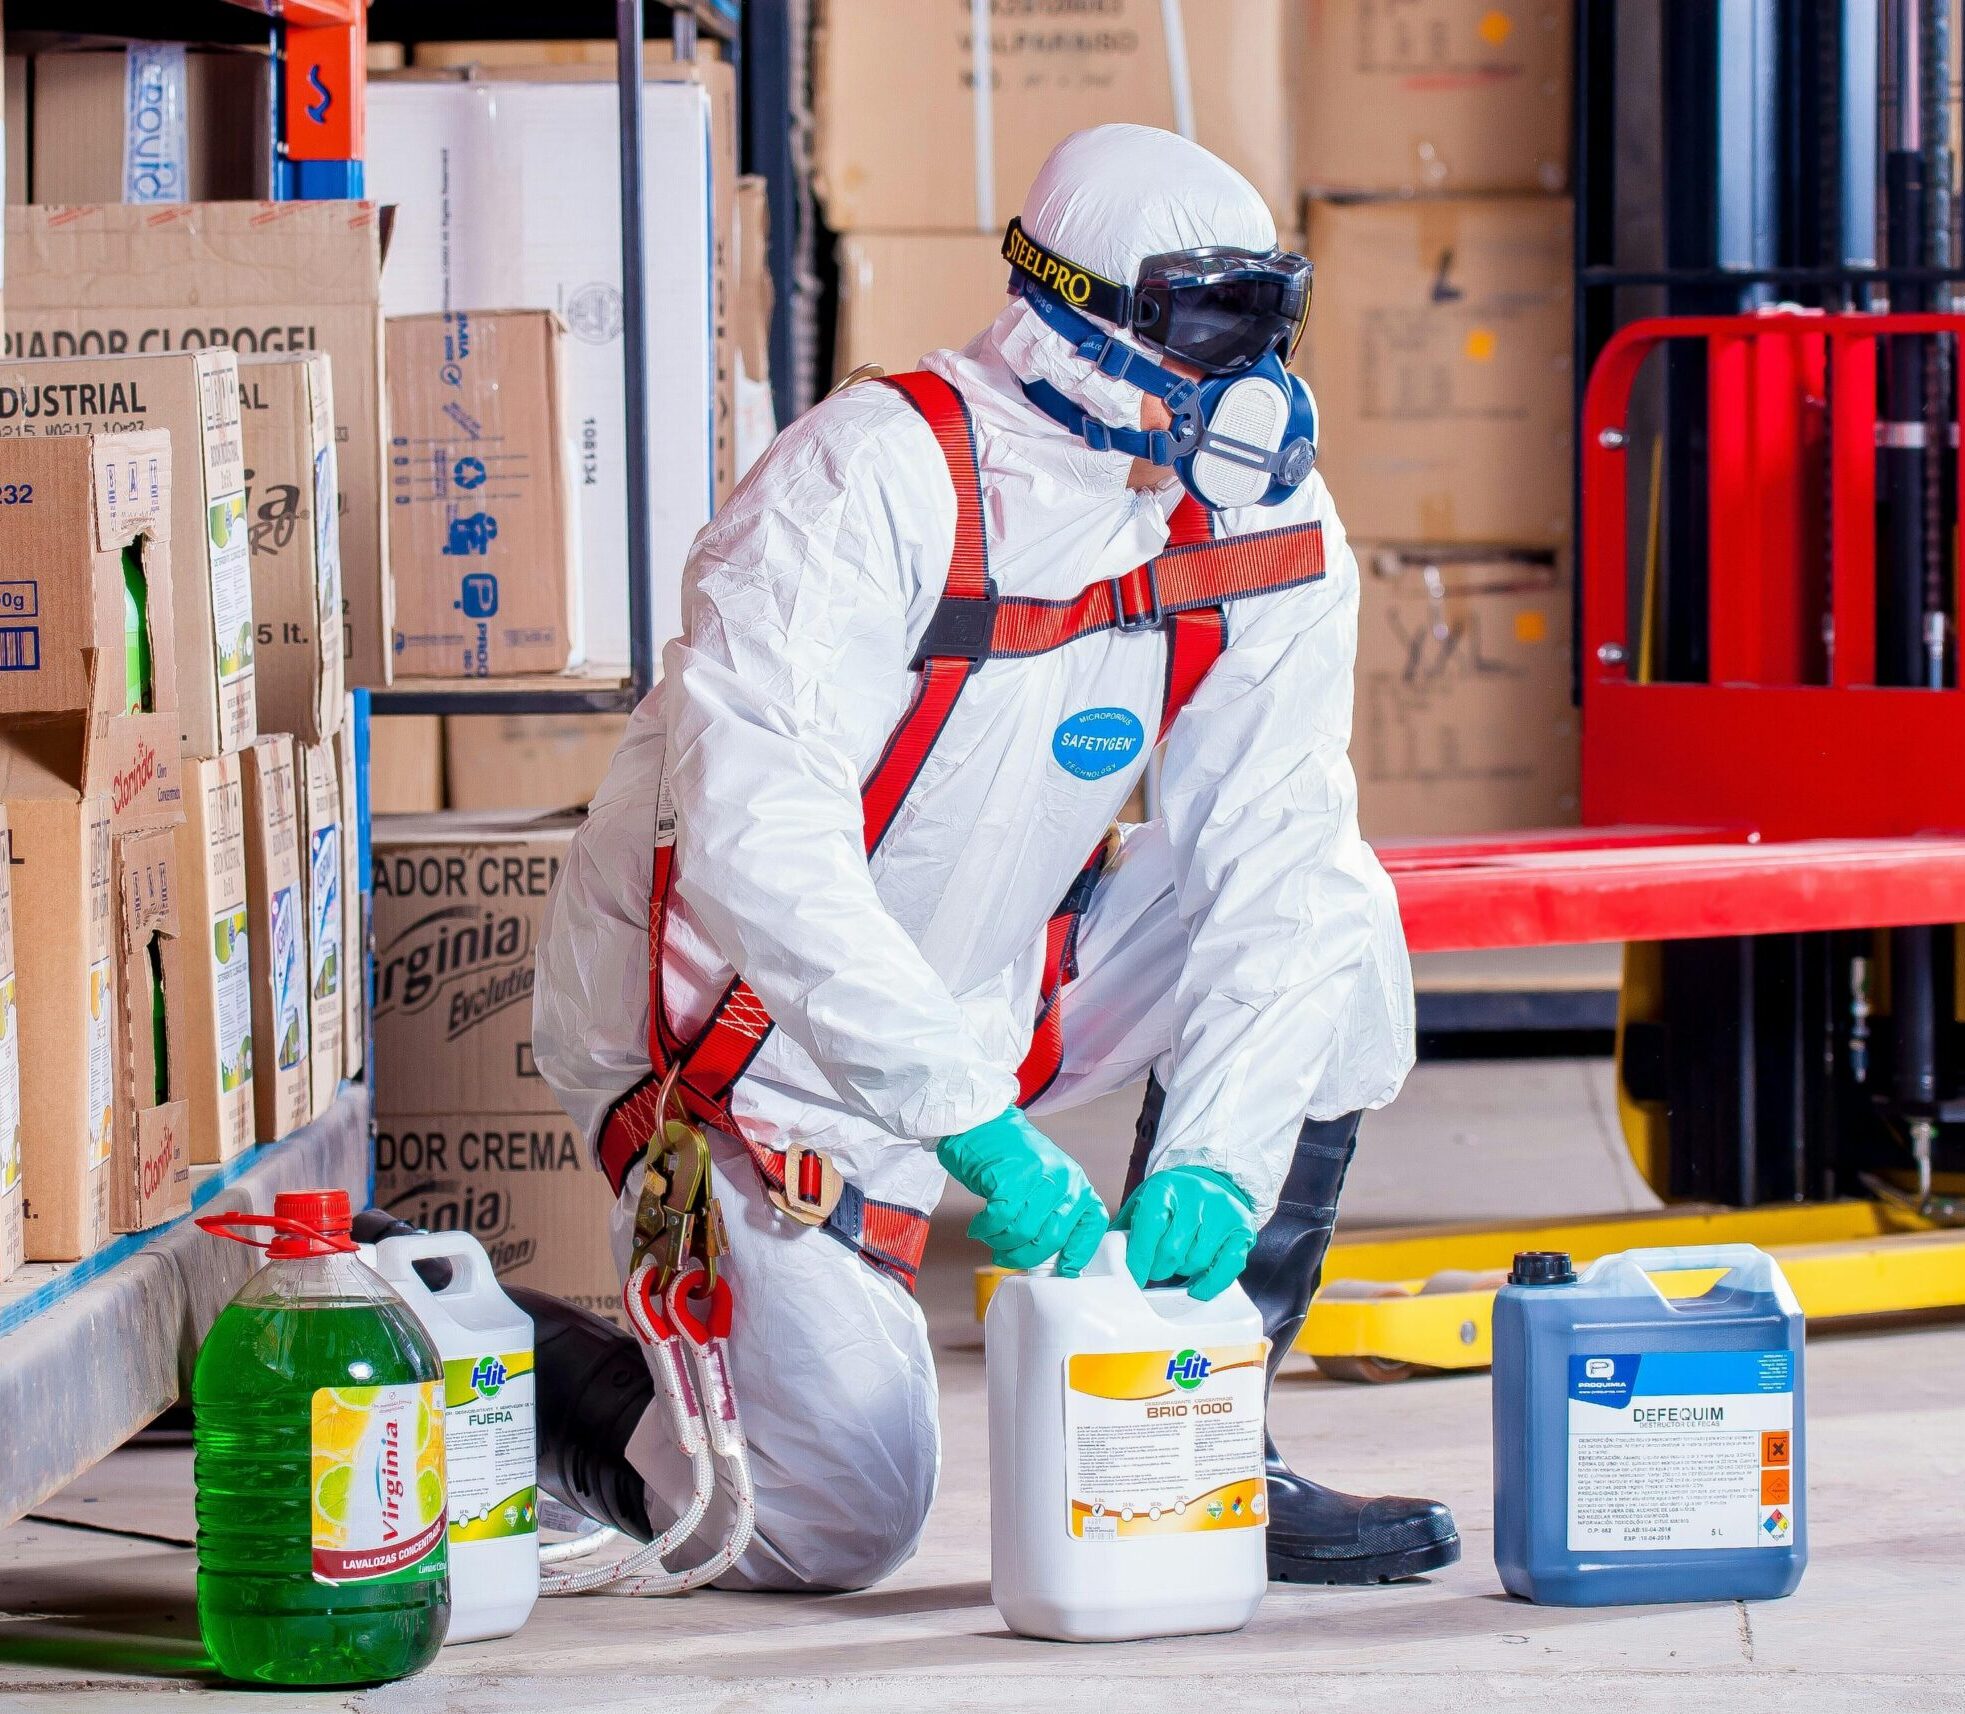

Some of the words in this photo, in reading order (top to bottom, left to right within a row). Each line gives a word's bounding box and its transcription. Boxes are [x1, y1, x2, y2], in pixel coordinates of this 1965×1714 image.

[1007, 228, 1091, 306] STEELPRO
[0, 484, 33, 505] 32
[257, 623, 273, 645] 5
[1061, 732, 1133, 752] SAFETYGEN
[1065, 760, 1117, 778] TECHNOLOGY
[458, 1131, 580, 1171] CREMA
[471, 1360, 508, 1388] Hit
[1166, 1353, 1212, 1380] Hit
[468, 1411, 513, 1426] FUERA
[1147, 1405, 1188, 1419] BRIO
[1192, 1402, 1233, 1416] 1000
[1633, 1407, 1724, 1422] DEFEQUIM
[381, 1422, 404, 1542] Virginia
[1711, 1528, 1716, 1536] 5
[1718, 1528, 1723, 1536] L
[342, 1552, 397, 1570] LAVALOZAS
